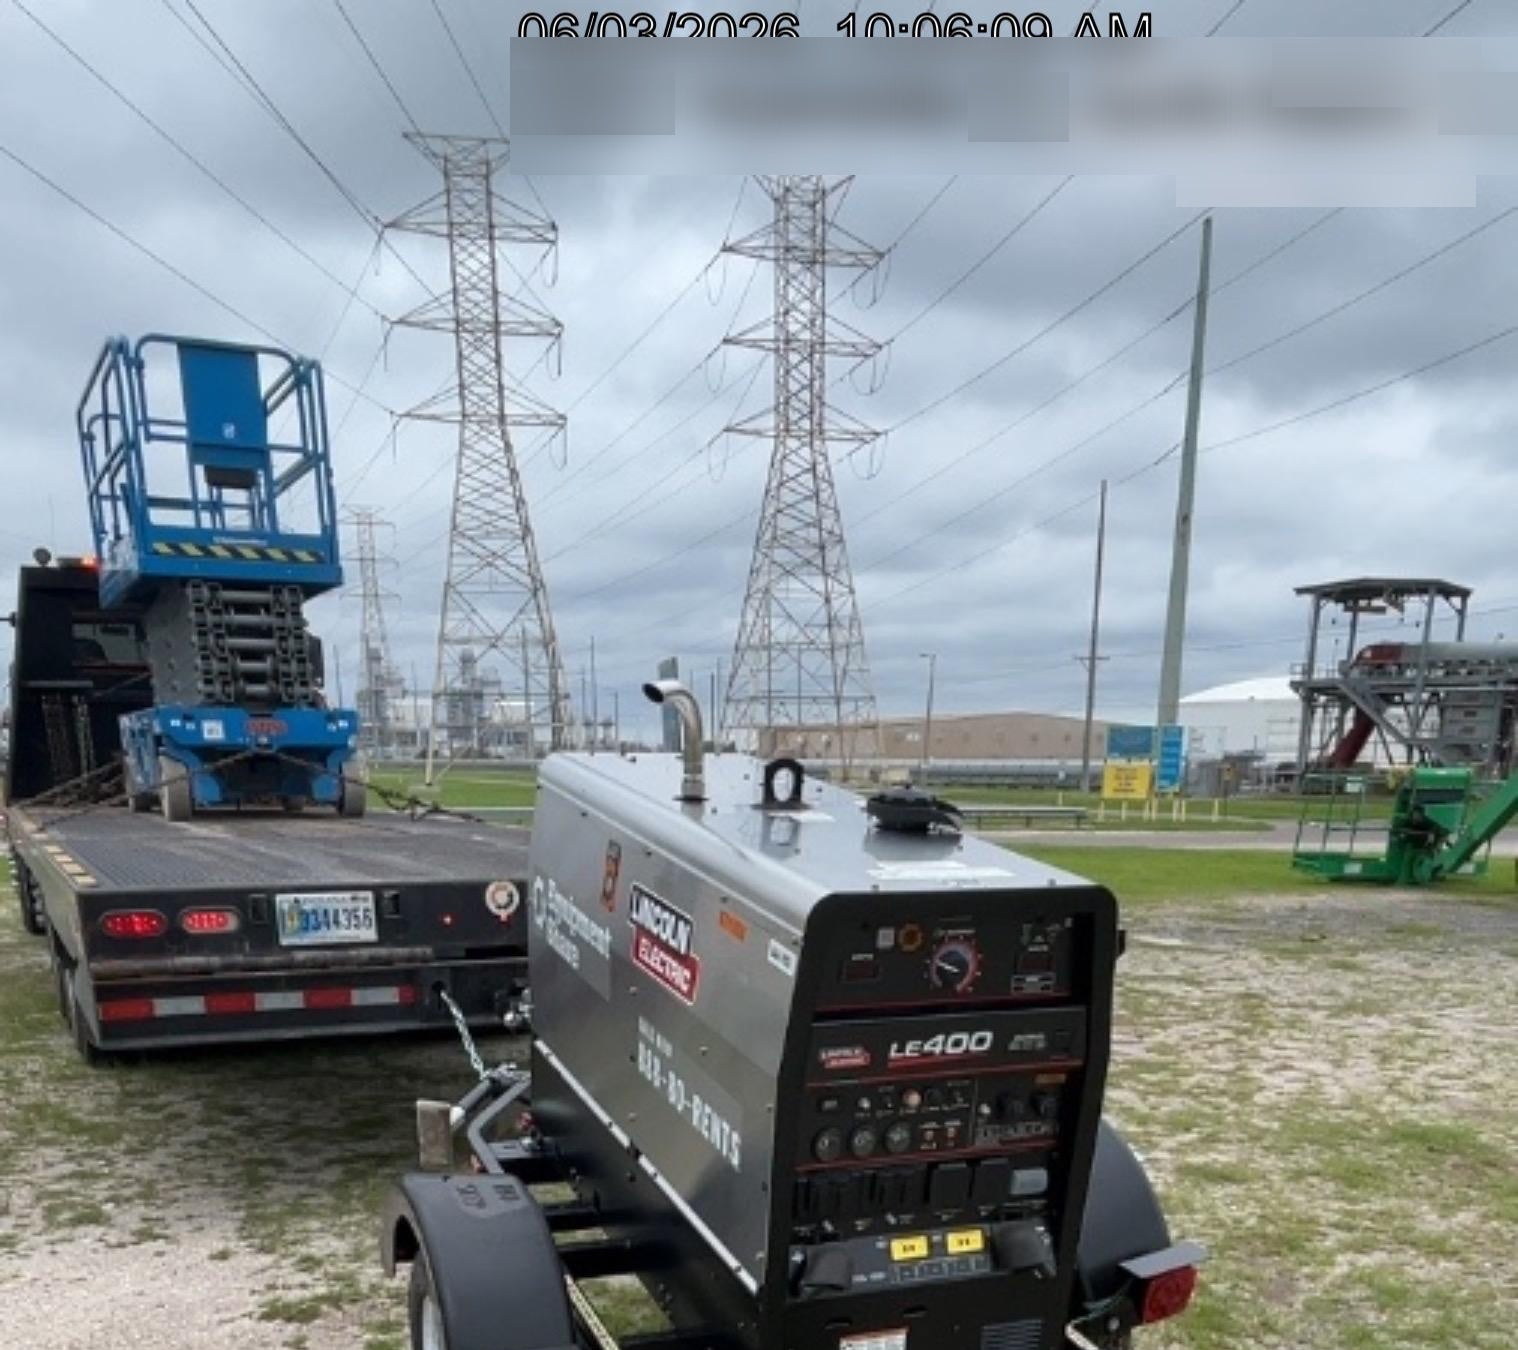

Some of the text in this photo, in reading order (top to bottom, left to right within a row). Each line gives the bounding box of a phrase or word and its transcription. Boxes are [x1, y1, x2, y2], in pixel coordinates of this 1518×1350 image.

[632, 892, 691, 955] LINCOLN
[639, 936, 692, 993] ELECTRIC
[890, 1031, 993, 1059] LE400
